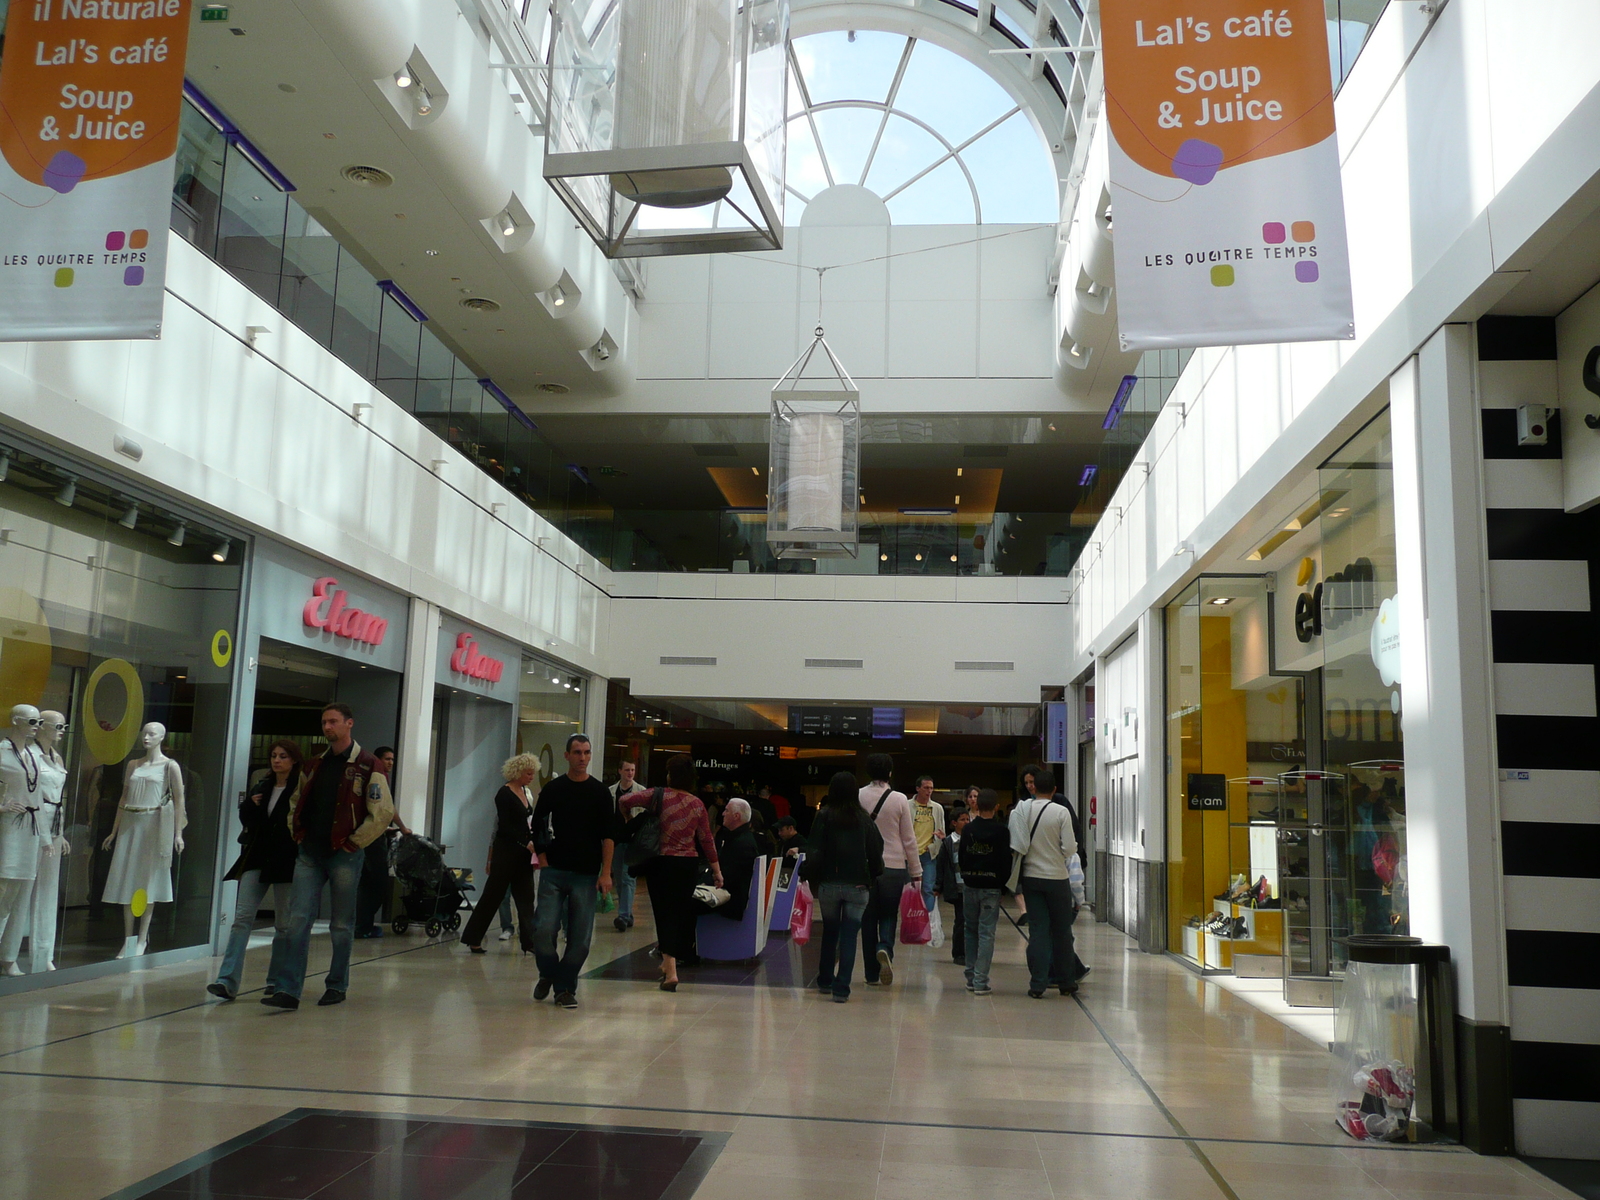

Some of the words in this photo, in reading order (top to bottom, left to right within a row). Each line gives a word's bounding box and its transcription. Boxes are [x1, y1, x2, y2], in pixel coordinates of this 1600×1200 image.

[34, 0, 50, 21] il
[61, 0, 180, 20] Naturale
[1135, 16, 1212, 47] Lal's
[1223, 9, 1293, 38] café
[36, 38, 99, 66] Lal's
[110, 37, 168, 64] café
[1174, 65, 1261, 94] Soup
[59, 84, 134, 114] Soup
[1157, 100, 1183, 129] &
[1194, 93, 1283, 126] Juice
[39, 115, 60, 141] &
[68, 114, 146, 140] Juice
[4, 254, 28, 266] LES
[103, 252, 147, 264] TEMPS
[1145, 254, 1174, 267] LES
[1263, 245, 1318, 260] TEMPS
[303, 576, 389, 646] Etam
[450, 632, 504, 683] Etam
[709, 758, 739, 772] Bruges
[1191, 794, 1223, 806] éram
